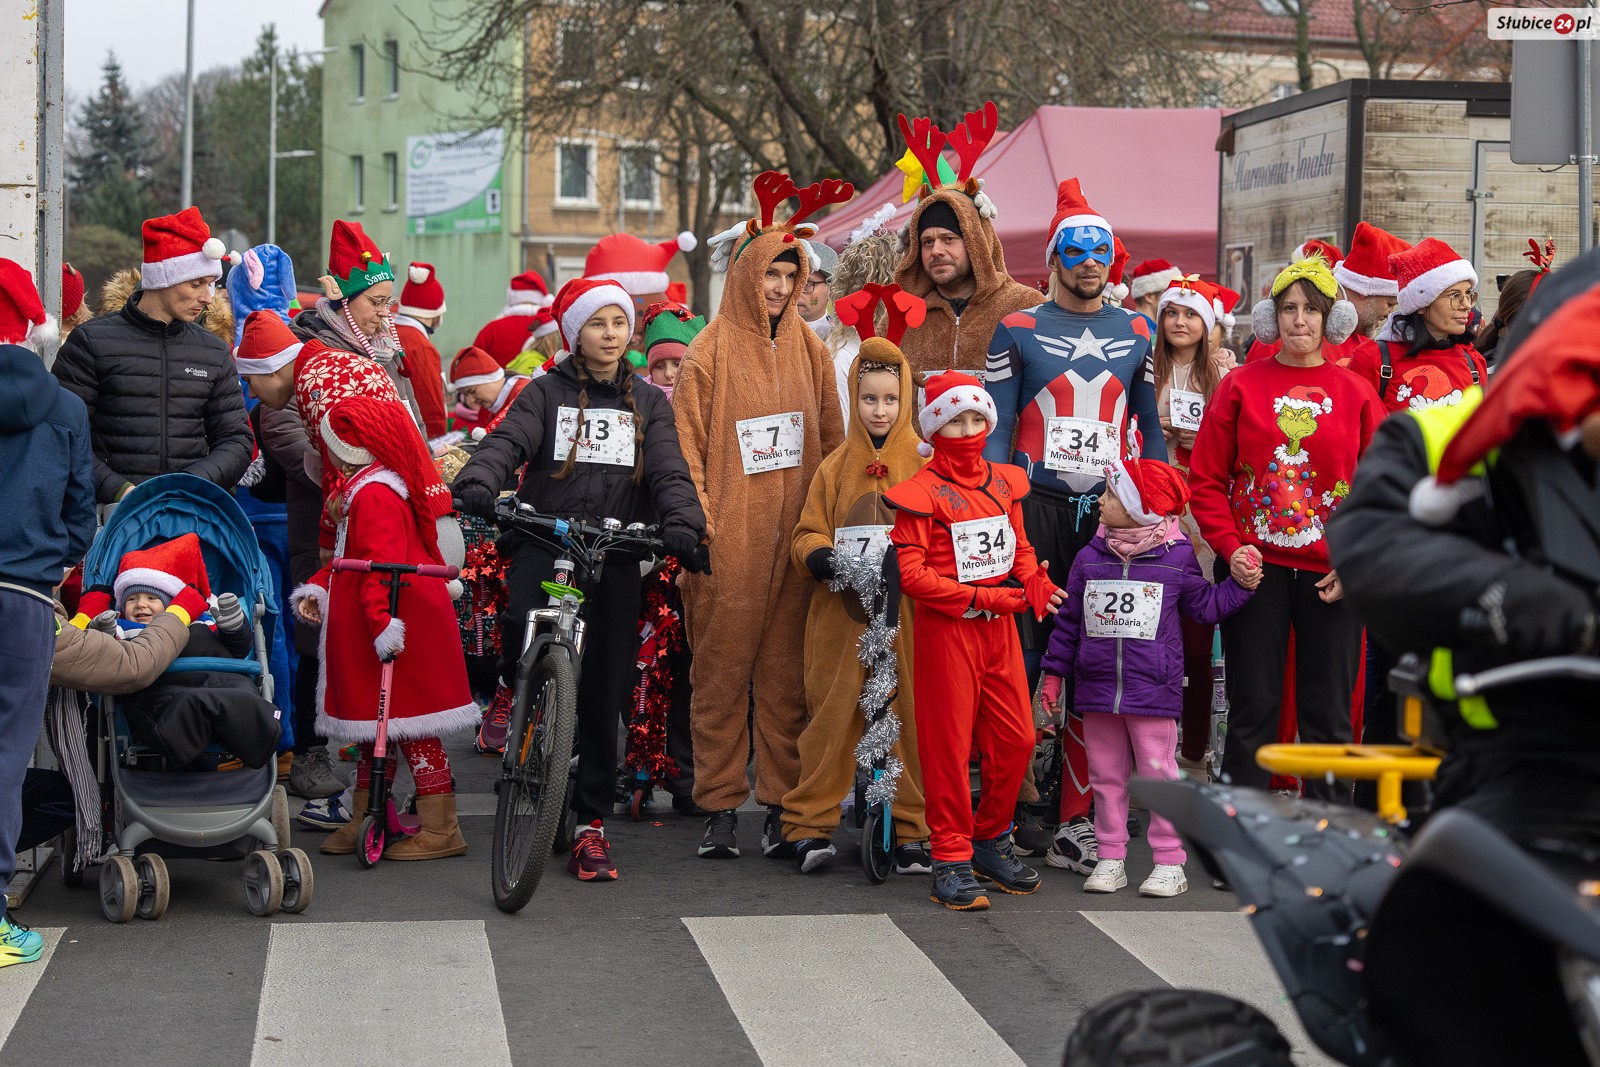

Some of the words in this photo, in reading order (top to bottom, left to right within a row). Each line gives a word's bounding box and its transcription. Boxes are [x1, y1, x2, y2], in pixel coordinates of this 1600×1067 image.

[1189, 401, 1206, 418] 6
[580, 419, 610, 441] 13
[766, 425, 780, 447] 7
[1069, 428, 1100, 453] 34
[590, 443, 601, 452] Fil
[752, 449, 783, 462] Chustki
[856, 537, 871, 558] 7
[977, 528, 1006, 555] 34
[1103, 591, 1135, 614] 28
[1100, 617, 1141, 627] LenaDaria
[378, 689, 387, 723] SMART
